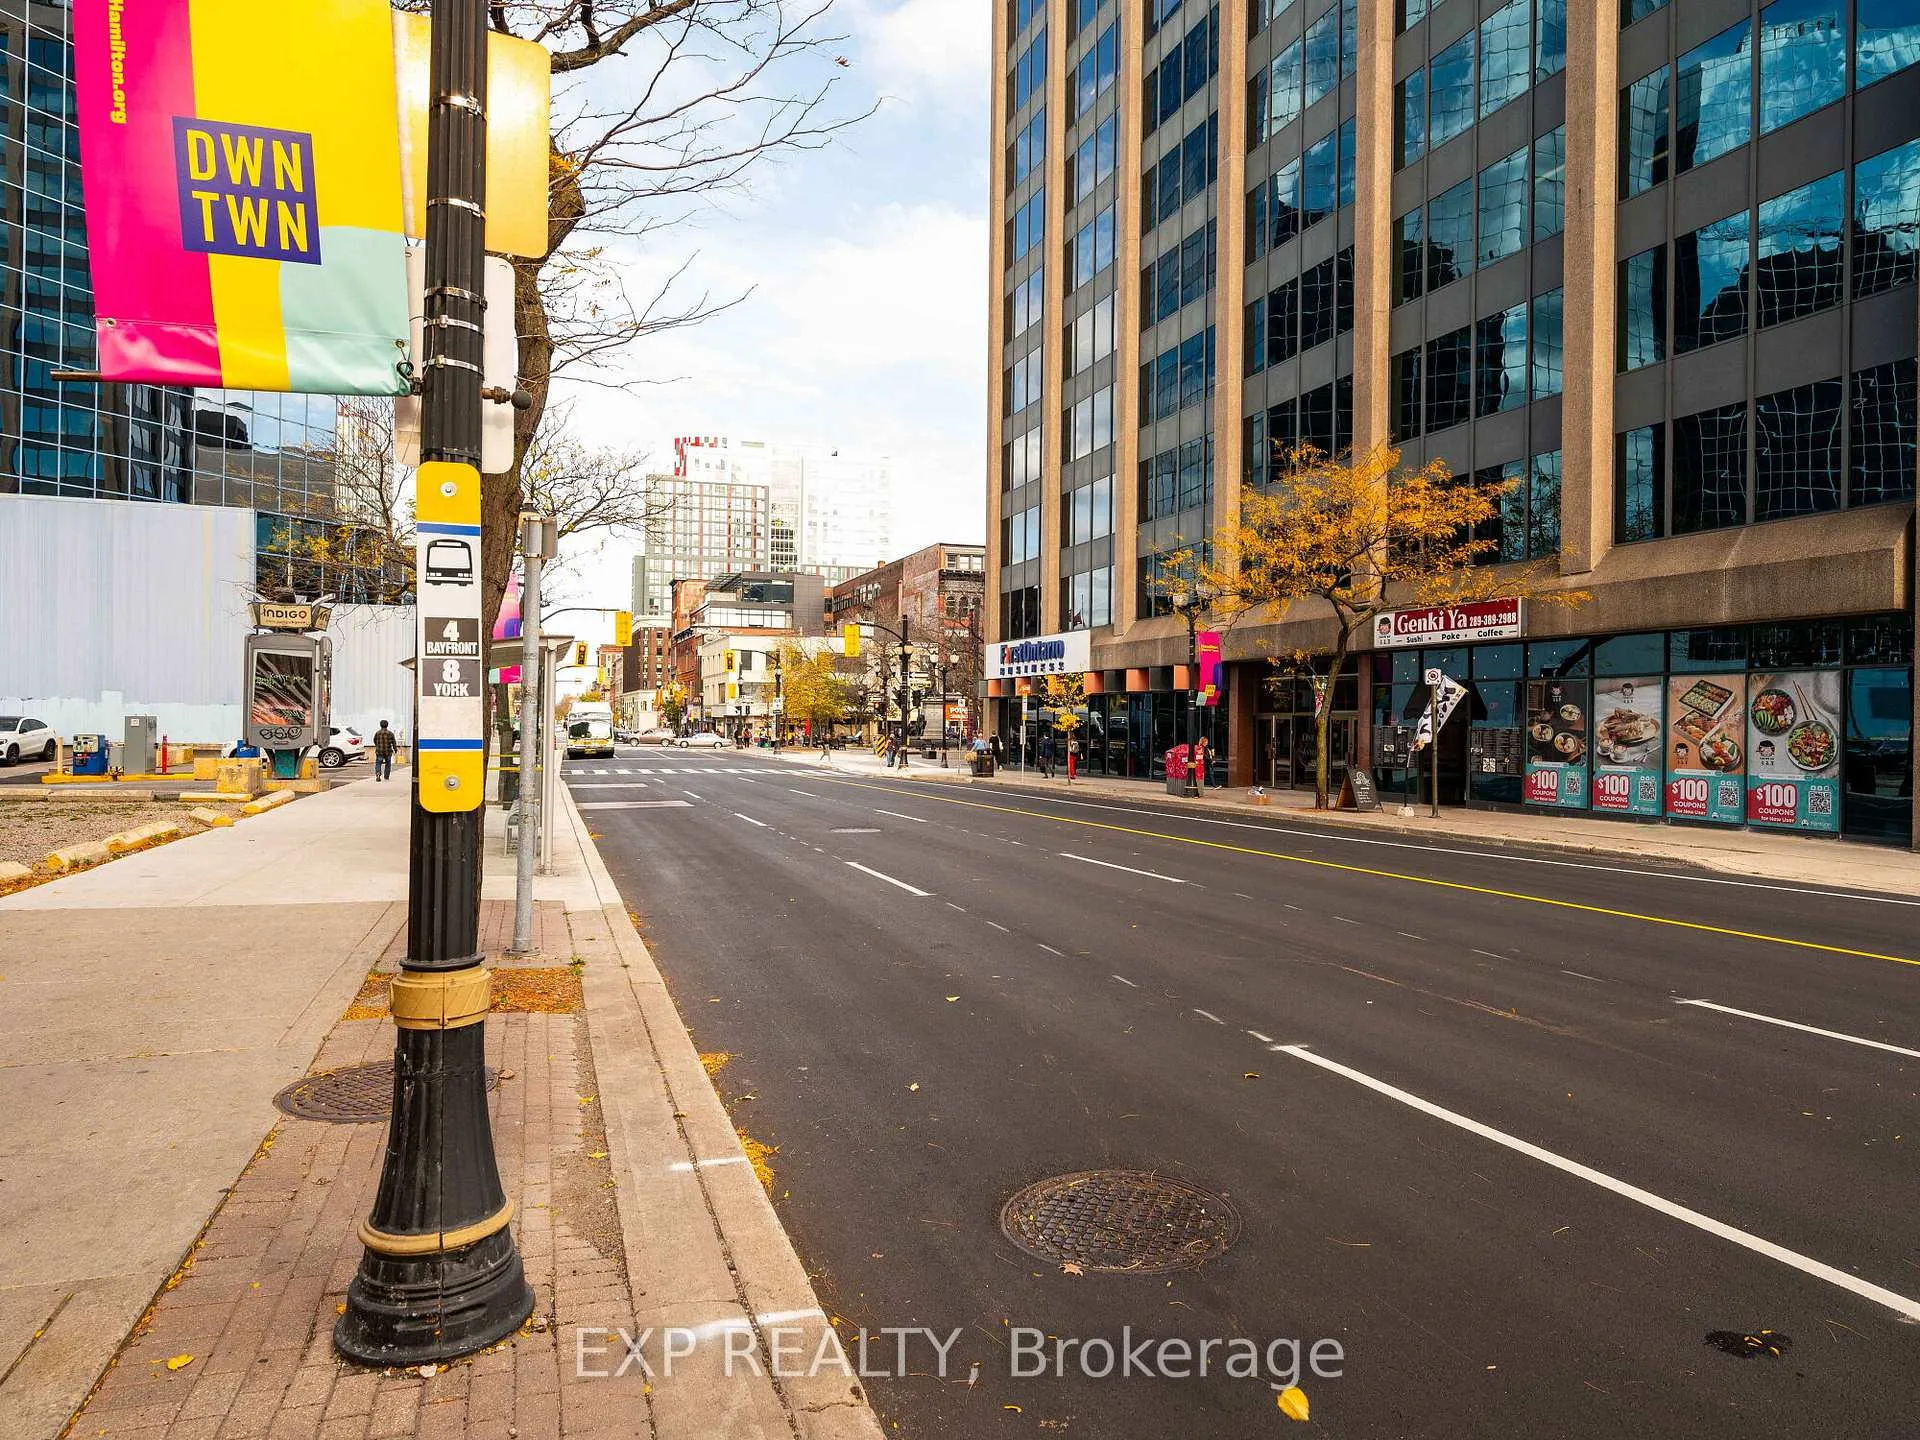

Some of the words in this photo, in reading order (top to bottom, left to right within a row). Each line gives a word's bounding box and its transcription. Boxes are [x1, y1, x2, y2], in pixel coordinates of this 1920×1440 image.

[186, 129, 304, 193] DWN
[191, 190, 309, 253] TWN
[442, 620, 460, 642] 4
[1397, 610, 1444, 633] Genki
[1448, 609, 1468, 629] Ya
[1406, 635, 1424, 643] Sushi
[1441, 632, 1460, 640] Poke
[1477, 628, 1504, 638] Coffee
[426, 641, 478, 655] BAYFRONT
[442, 659, 460, 683] 8
[433, 682, 470, 697] YORK
[1531, 770, 1557, 790] $100
[1598, 775, 1629, 796] $100
[1672, 779, 1708, 801] $100
[1673, 800, 1706, 809] COUPONS
[1756, 784, 1796, 808] $100
[1758, 807, 1796, 817] COUPONS
